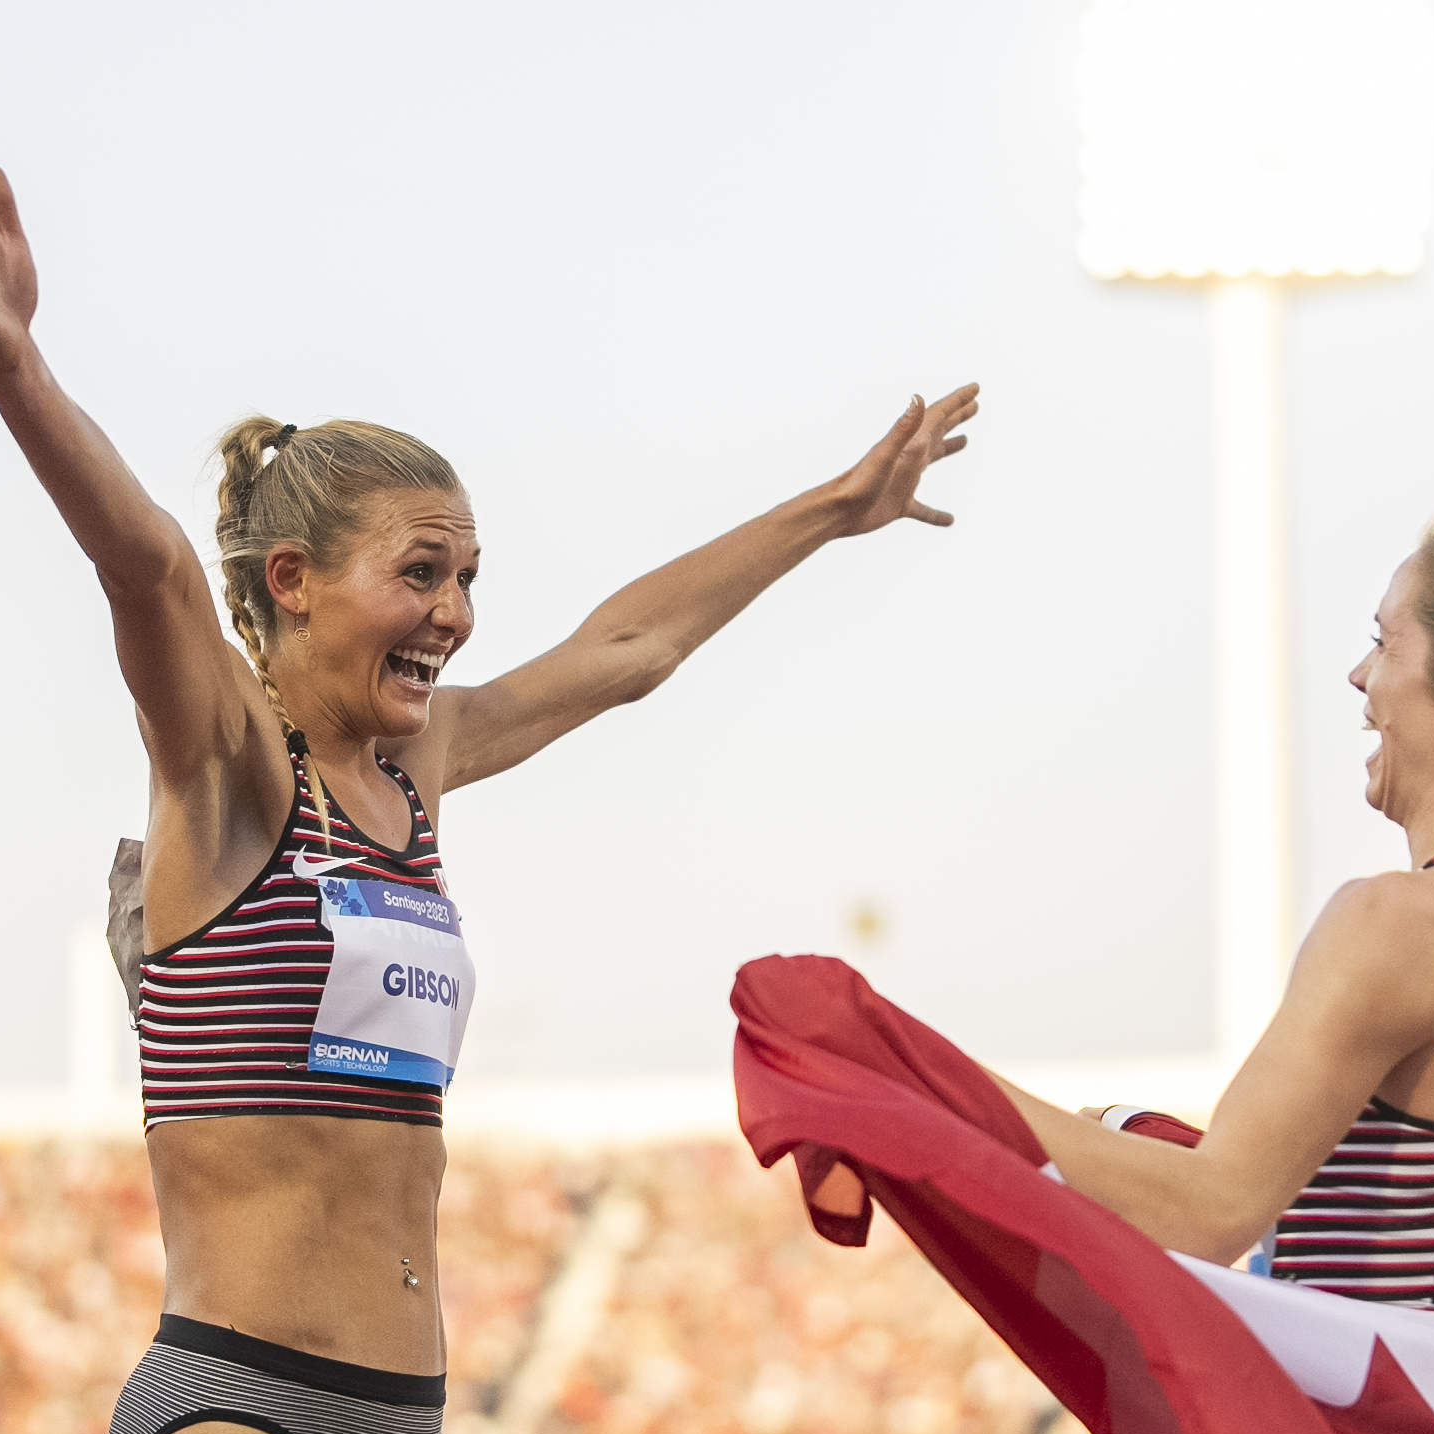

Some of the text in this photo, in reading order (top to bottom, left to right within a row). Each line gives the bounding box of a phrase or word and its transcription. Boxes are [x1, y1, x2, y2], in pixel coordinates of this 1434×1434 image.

[383, 890, 449, 924] Santiago 2023
[383, 963, 460, 1011] GIBSON
[314, 1042, 390, 1065] BORNAN
[314, 1058, 387, 1073] SPORTS TECHNOLOGY
